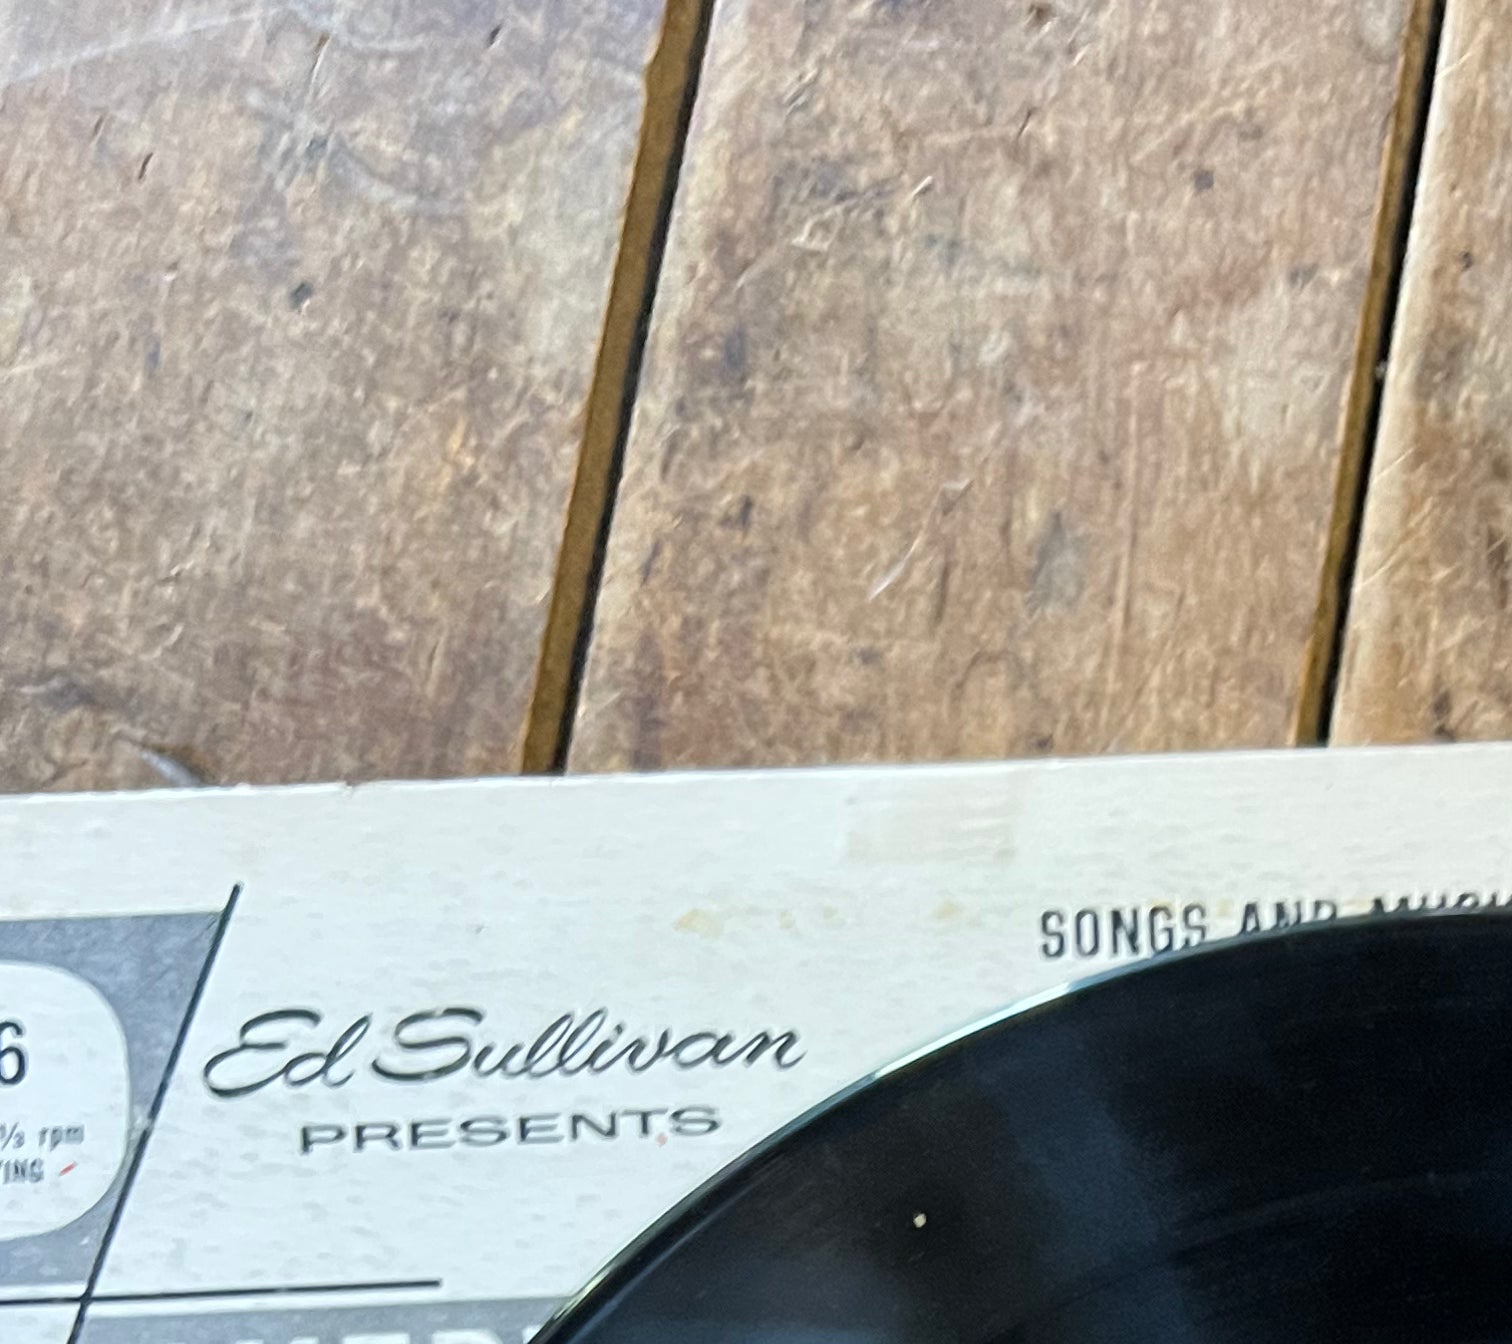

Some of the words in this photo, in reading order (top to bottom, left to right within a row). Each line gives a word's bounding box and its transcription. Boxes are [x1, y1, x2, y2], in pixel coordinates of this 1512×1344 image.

[1039, 902, 1207, 959] SONGS
[203, 1008, 371, 1098] Ed
[369, 1006, 808, 1083] Sullivan
[38, 1122, 85, 1152] rpm
[300, 1106, 723, 1155] PRESENTS
